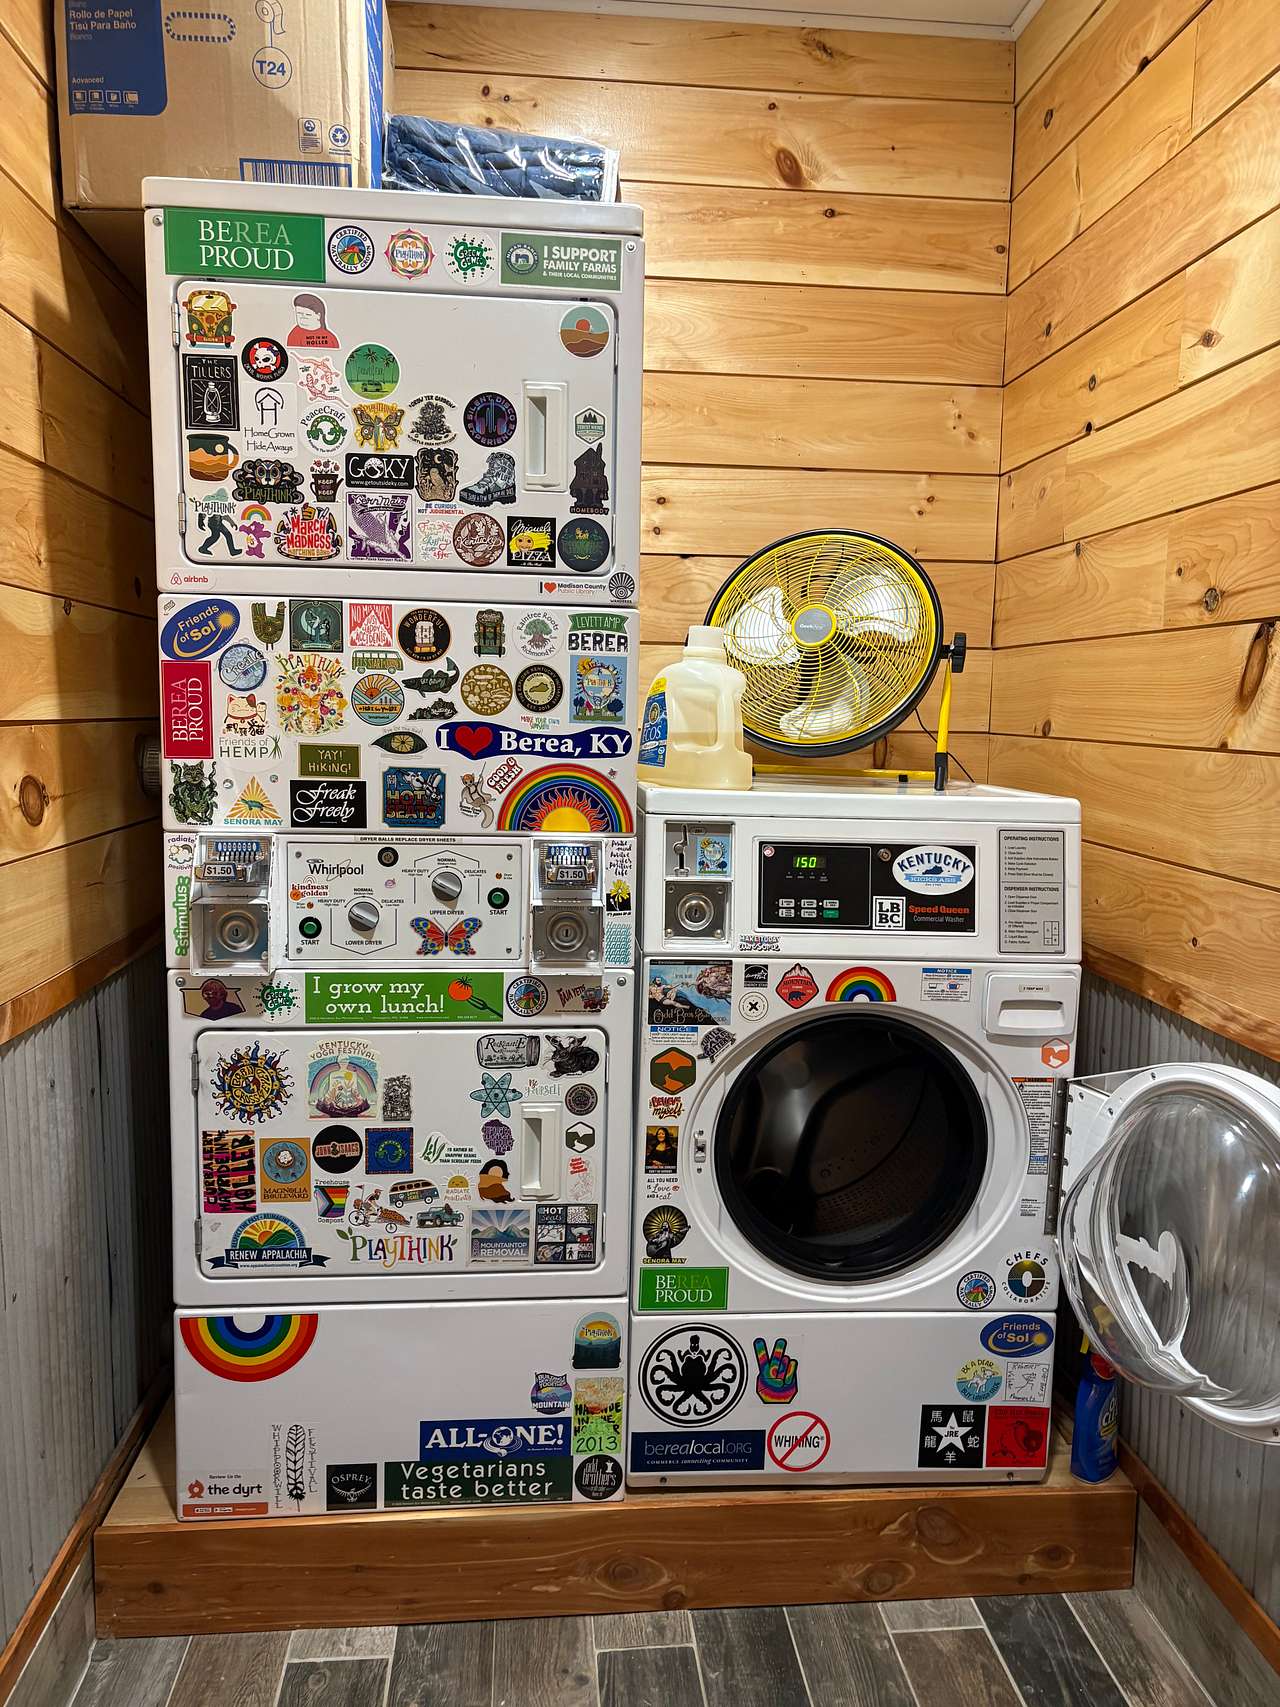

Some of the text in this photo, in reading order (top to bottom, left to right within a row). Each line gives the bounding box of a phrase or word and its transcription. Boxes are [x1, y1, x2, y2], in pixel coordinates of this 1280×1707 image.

[70, 9, 133, 20] Rollo de Papel
[90, 19, 137, 30] Para Baño
[256, 60, 287, 76] T24
[198, 219, 292, 246] BEREA
[335, 228, 368, 242] CERTIFIED
[199, 245, 294, 270] PROUD
[332, 244, 371, 271] NATURALLY GROWN
[543, 246, 617, 263] I SUPPORT
[543, 259, 617, 274] FAMILY FARMS
[191, 365, 232, 379] TILLERS
[467, 395, 516, 421] SILENT DISCO
[300, 405, 346, 427] PeaceCraft
[244, 426, 295, 439] HomeGrown
[468, 423, 516, 446] EXPERIENCE
[246, 440, 293, 454] HideAways
[291, 515, 327, 535] MARCH
[287, 534, 332, 549] MADNESS
[456, 534, 501, 549] Kentucky
[511, 551, 552, 562] PIZZA
[183, 575, 209, 583] airbnb
[557, 582, 606, 591] Madison County
[575, 589, 596, 597] Library
[177, 604, 220, 632] Friends
[403, 613, 445, 629] WONDERFUL
[517, 612, 559, 631] Raintree Roots
[577, 616, 621, 628] LEVITT AMP
[180, 620, 217, 643] of Sol
[521, 645, 557, 657] Richmond KY
[171, 678, 189, 742] BEREA
[187, 677, 204, 742] PROUD
[219, 736, 269, 746] Friends of
[641, 725, 661, 743] ECOS
[438, 728, 630, 757] I Berea, KY
[219, 746, 269, 759] HEMP
[318, 749, 343, 761] YAY!
[488, 764, 509, 787] GOOD
[495, 766, 522, 793] FRESH
[223, 818, 261, 826] SENORA
[167, 835, 195, 844] radiate
[796, 856, 817, 868] 150
[896, 852, 971, 873] KENTUCKY
[206, 866, 232, 875] $1.50
[308, 863, 364, 878] Whirlpool
[559, 870, 583, 879] $1.50
[878, 901, 901, 913] LB
[908, 904, 970, 914] Speed Queen
[174, 884, 189, 947] stimulus
[878, 913, 901, 924] BC
[312, 976, 424, 999] I grow my
[512, 977, 542, 989] CERTIFIED
[326, 994, 444, 1014] own lunch!
[508, 993, 535, 1015] NATURALLY
[318, 1040, 369, 1050] KENTUCKY
[310, 1047, 376, 1061] YOGA FESTIVAL
[231, 1065, 255, 1087] BORN
[263, 1186, 308, 1194] MAGNOLIA
[229, 1249, 308, 1260] RENEW APPALACHIA
[350, 1234, 453, 1268] PLAYTHINK
[480, 1248, 527, 1257] REMOVAL
[1005, 1251, 1049, 1267] CHEFS
[655, 1274, 712, 1289] BEREA
[963, 1273, 991, 1283] CERTIFIED
[655, 1289, 713, 1303] PROUD
[1001, 1281, 1051, 1304] COLLABORATIVE
[1002, 1322, 1041, 1331] Friends
[997, 1331, 1030, 1343] of Sol
[532, 1401, 570, 1409] MOUNTAIN
[930, 1410, 942, 1423] 馬
[962, 1410, 975, 1423] 鼠
[576, 1436, 618, 1453] 2013
[774, 1435, 820, 1449] WHINING
[924, 1435, 937, 1448] 龍
[967, 1435, 980, 1448] 蛇
[308, 1428, 320, 1493] FESTIVAL
[944, 1451, 957, 1464] 羊
[400, 1460, 546, 1483] Vegetarians
[582, 1470, 616, 1486] brothers
[331, 1474, 372, 1484] OSPREY
[208, 1483, 262, 1498] the dyrt
[401, 1479, 553, 1500] taste better
